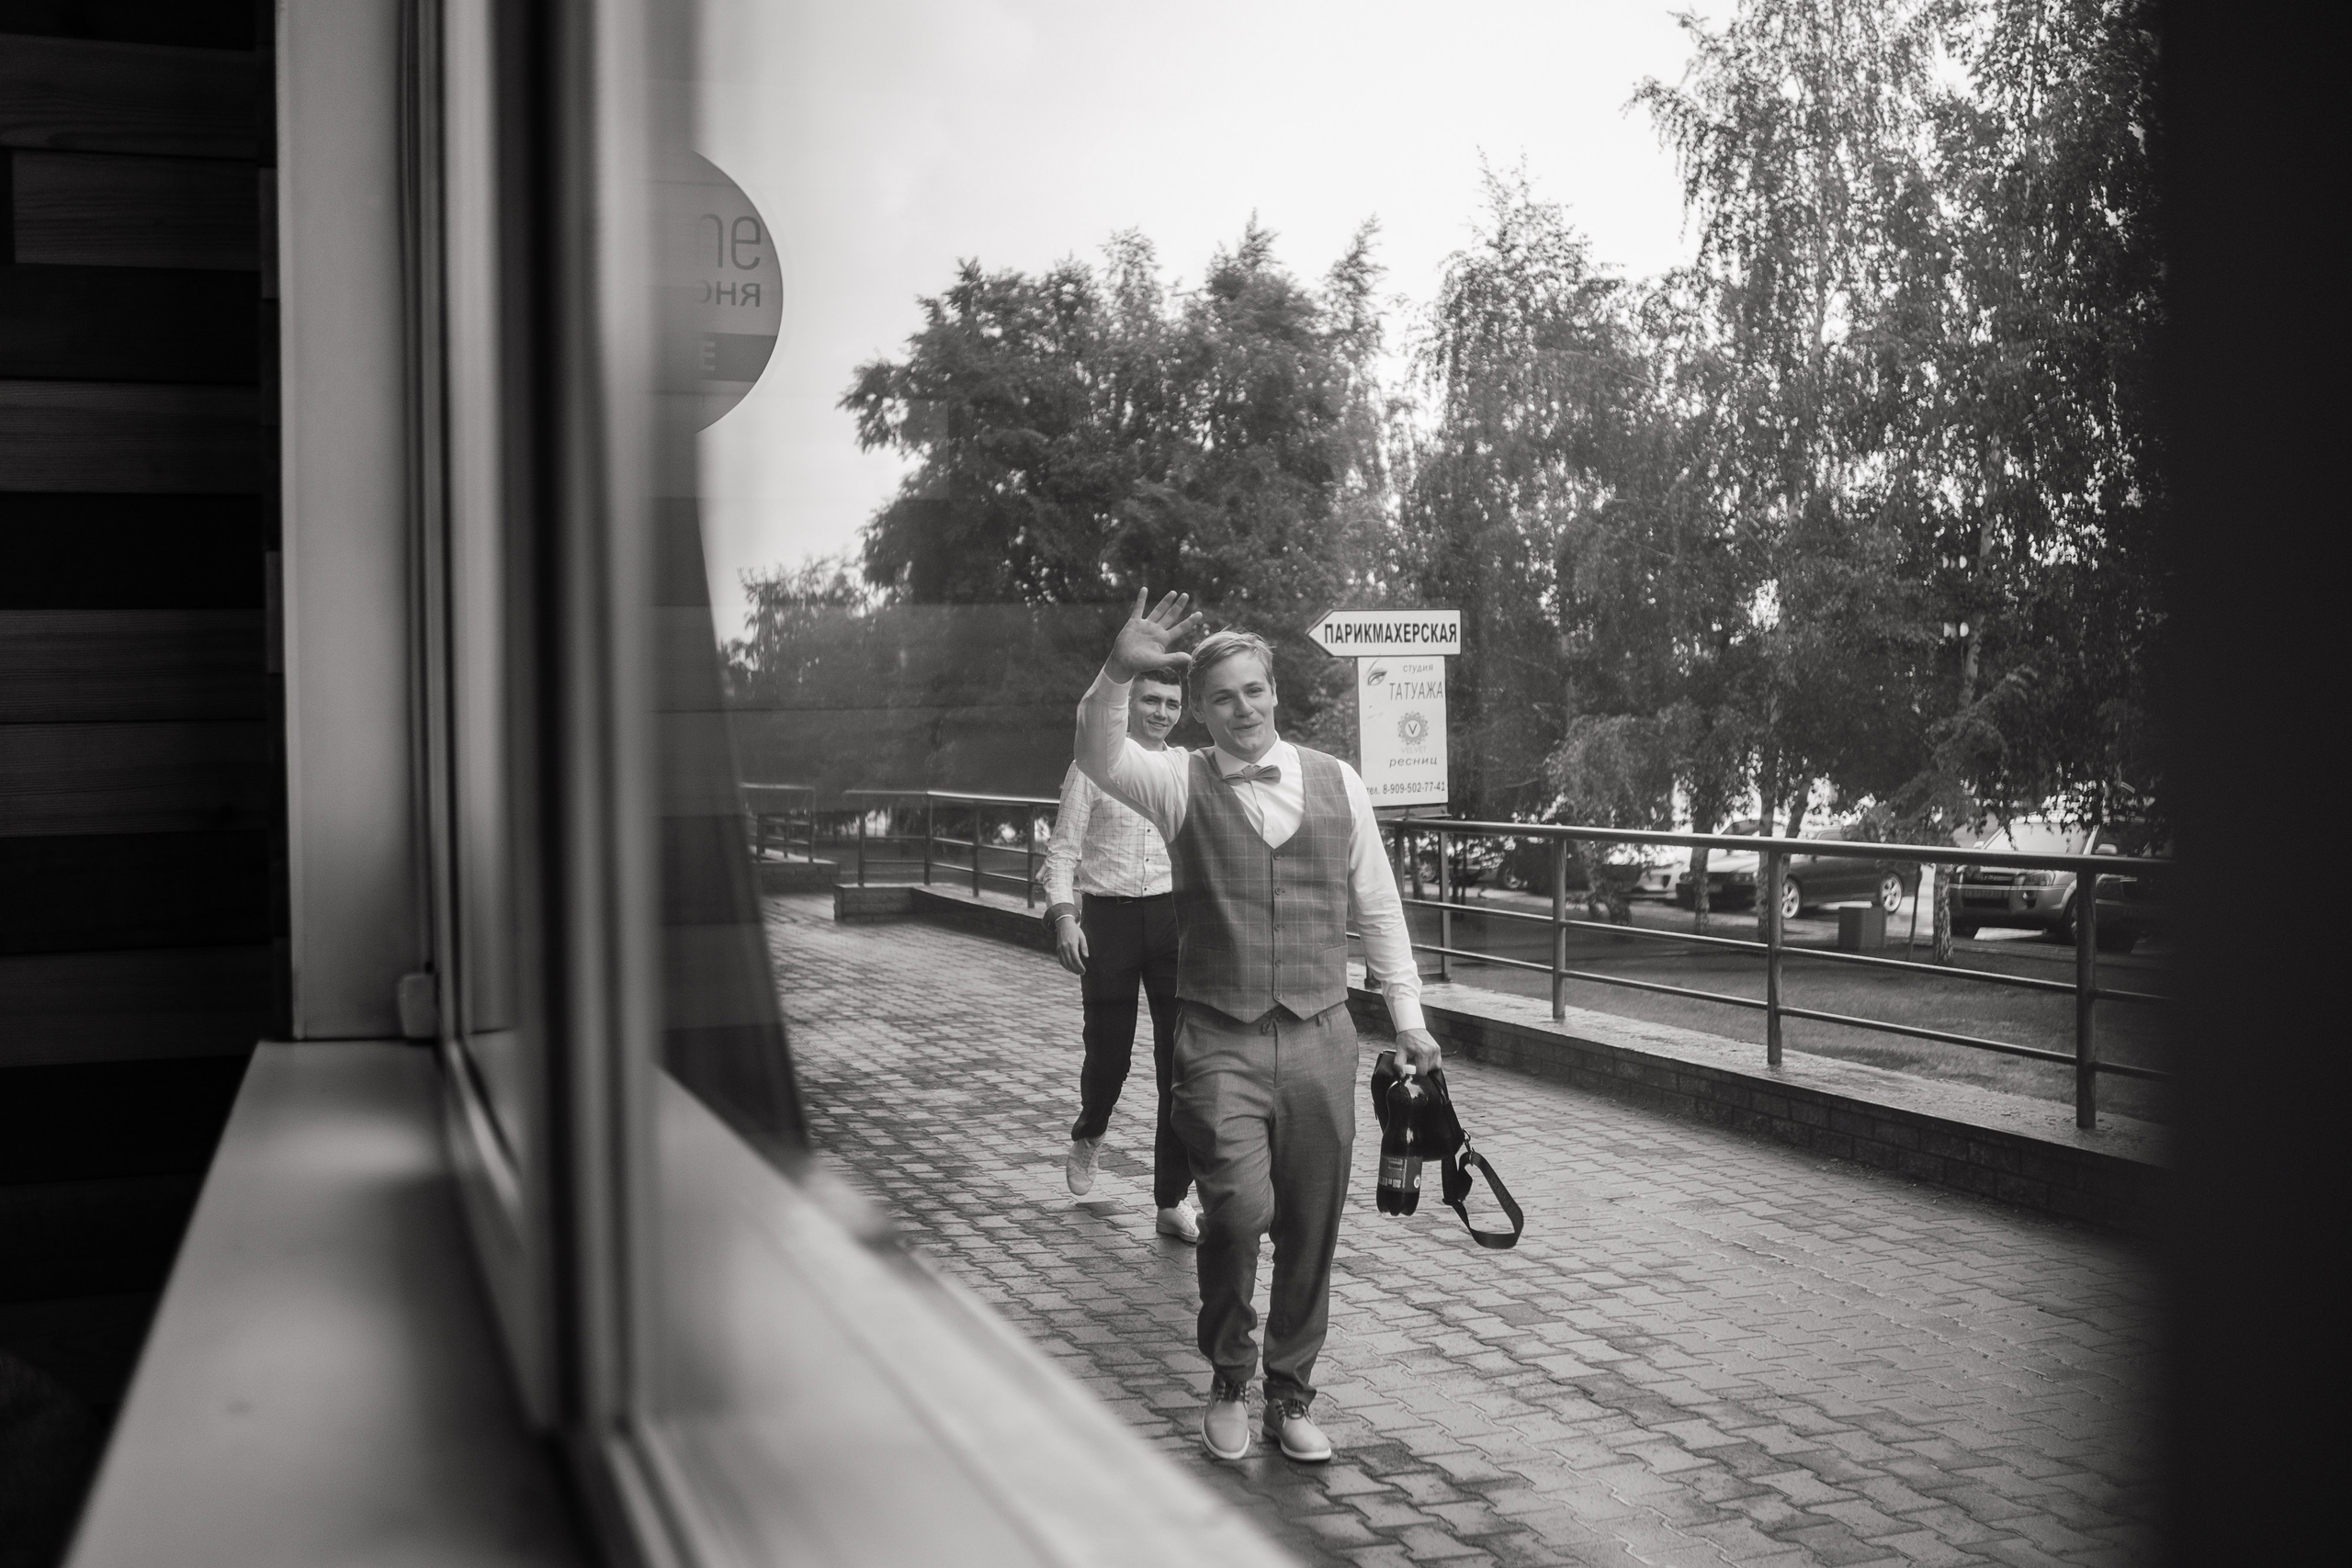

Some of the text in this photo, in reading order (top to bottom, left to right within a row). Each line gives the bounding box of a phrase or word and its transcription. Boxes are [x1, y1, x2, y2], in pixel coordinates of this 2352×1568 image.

[1324, 622, 1457, 644] ПАРИКМАХЕРСКАЯ
[1403, 663, 1434, 674] студия
[1389, 681, 1443, 701] ТАТУАЖА
[1389, 757, 1438, 768] ресниц
[1383, 781, 1446, 795] 8-909-502-77-41
